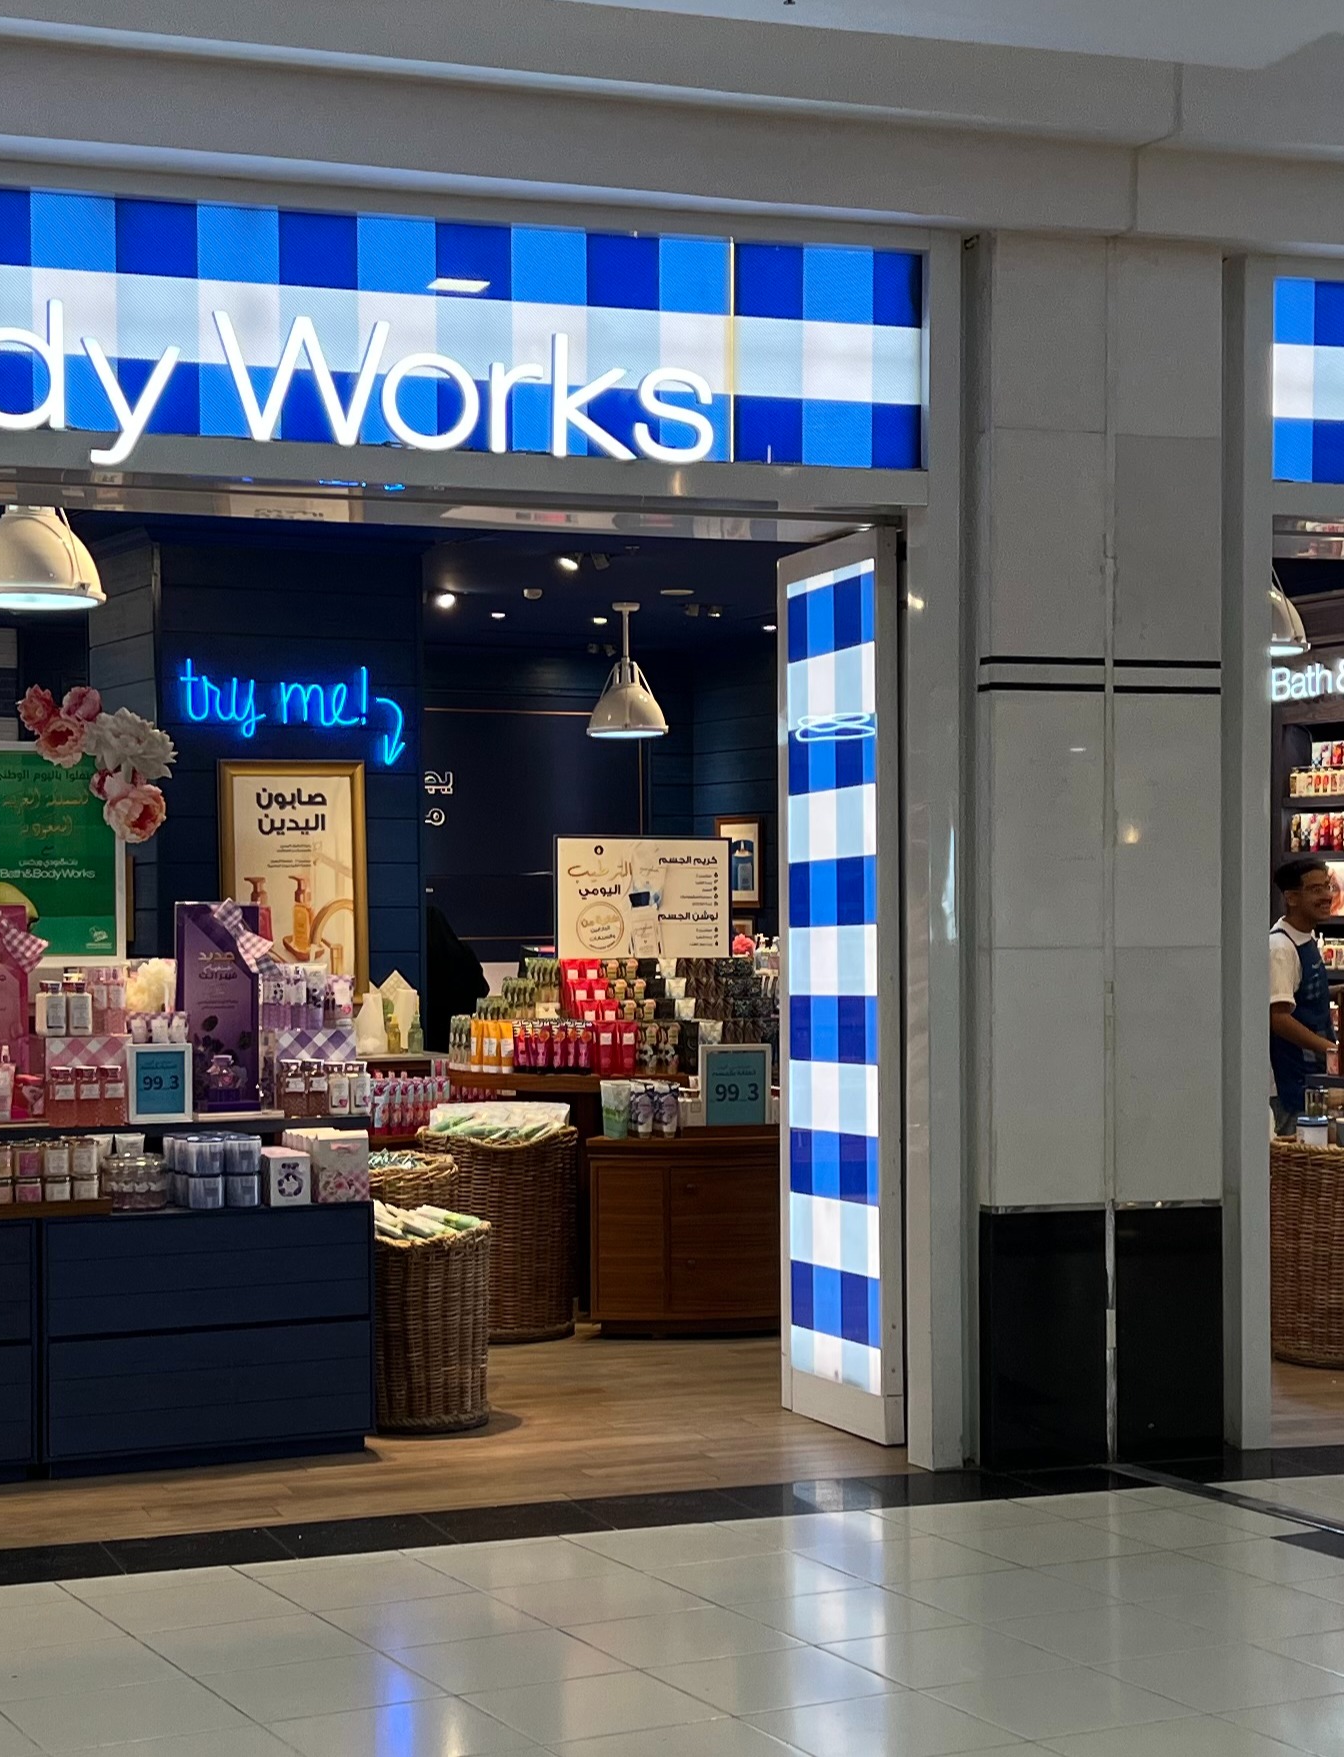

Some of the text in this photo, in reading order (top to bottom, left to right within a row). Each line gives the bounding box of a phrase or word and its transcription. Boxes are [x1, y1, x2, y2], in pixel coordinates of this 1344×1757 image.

[212, 309, 715, 465] Works
[1270, 661, 1333, 702] Bath
[180, 658, 368, 738] try me!
[255, 787, 327, 811] صابون
[257, 813, 326, 835] اليدين
[659, 855, 718, 866] كريم الجسم
[579, 884, 621, 900] اليومي
[658, 912, 690, 922] الجسم
[715, 1083, 740, 1102] 99
